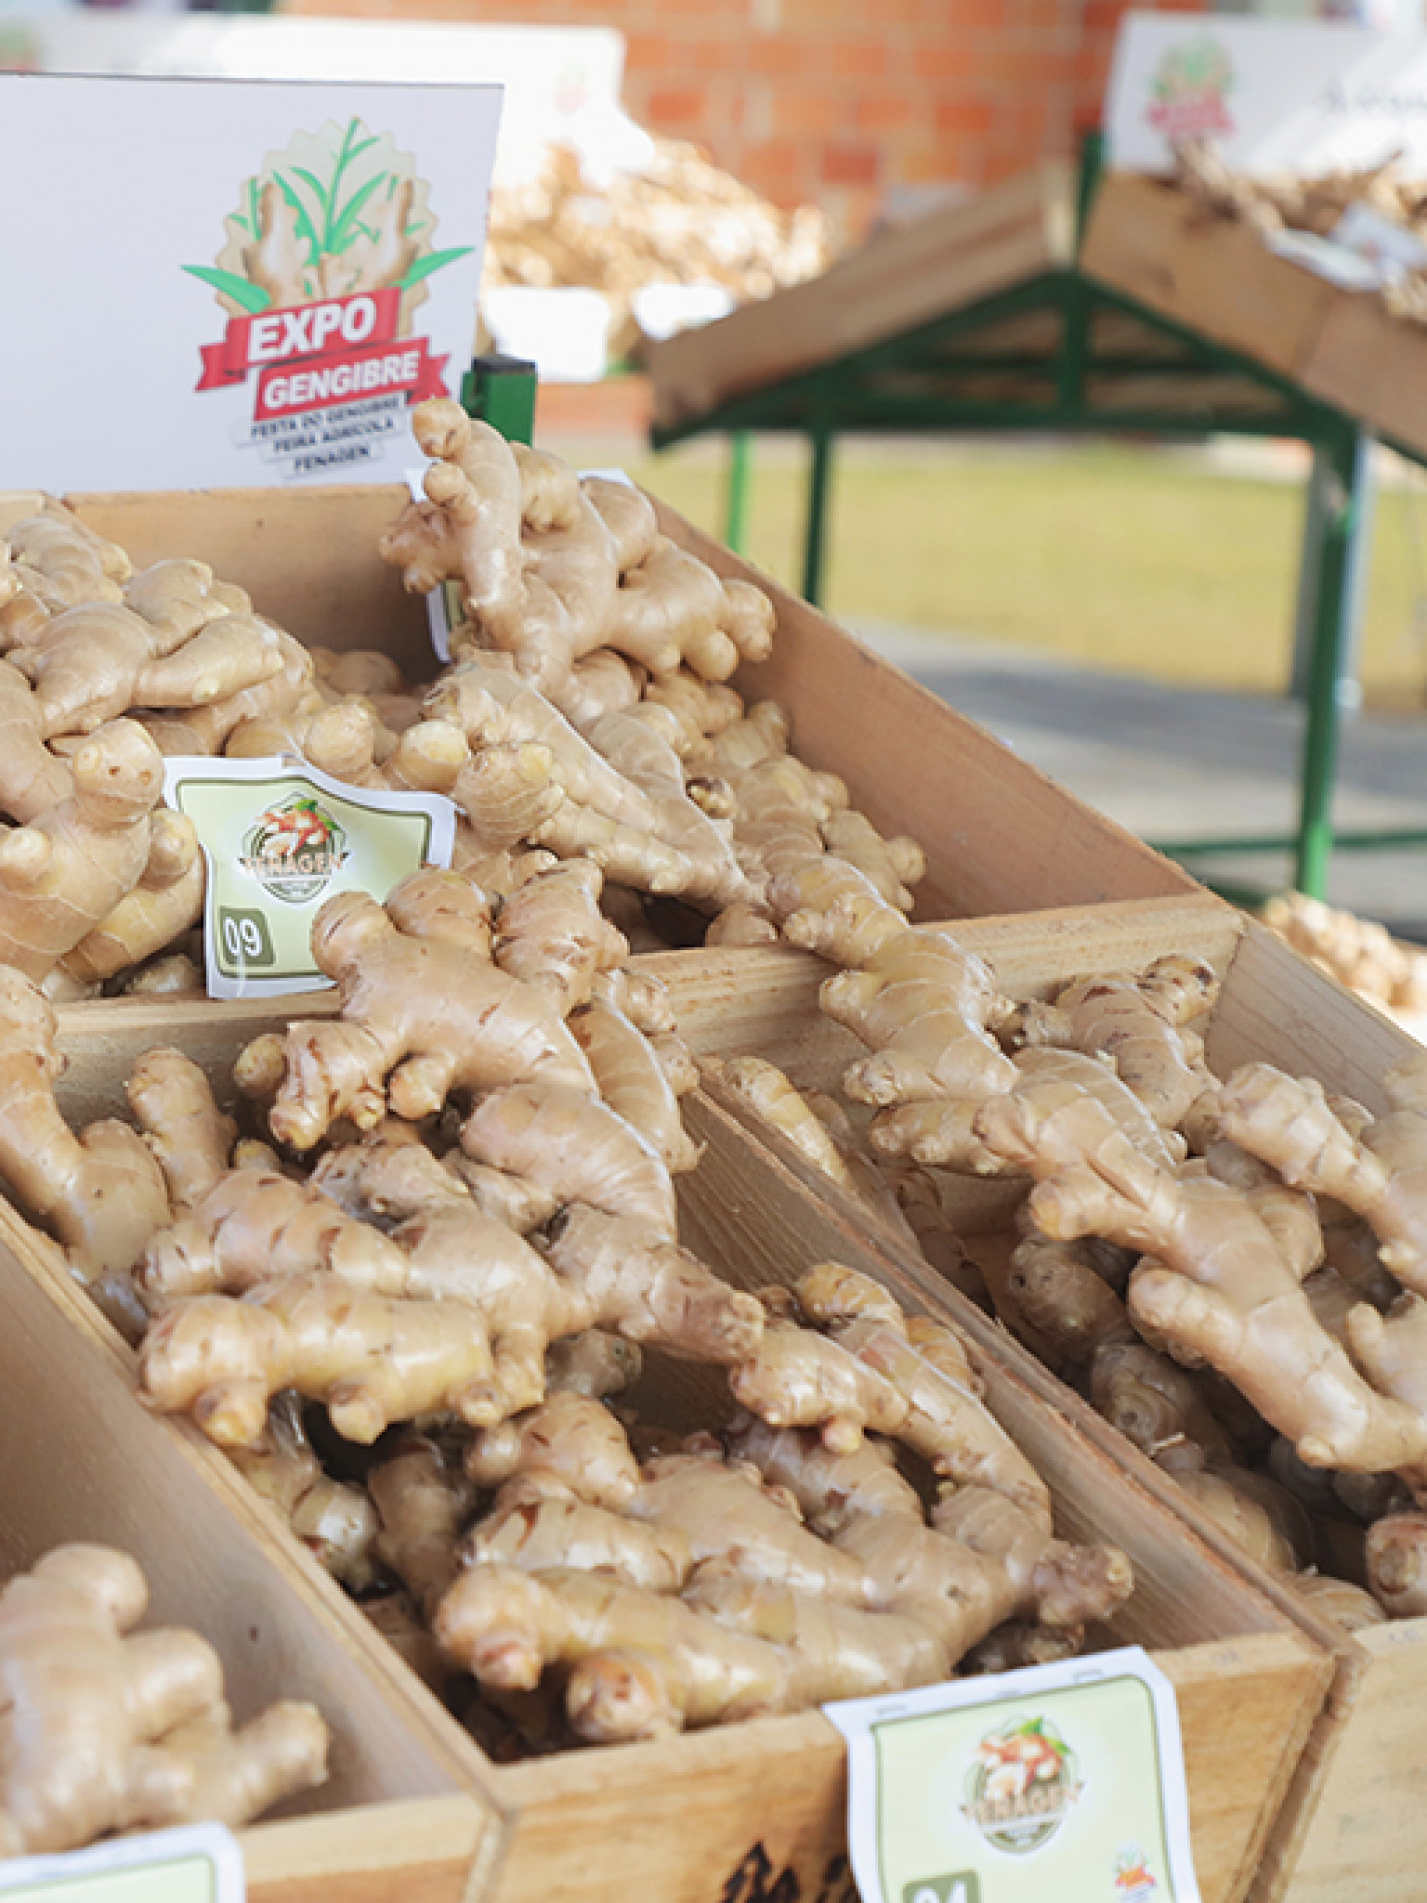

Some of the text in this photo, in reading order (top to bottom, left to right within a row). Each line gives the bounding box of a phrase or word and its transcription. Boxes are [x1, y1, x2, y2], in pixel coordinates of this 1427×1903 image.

[248, 297, 376, 361] EXPO
[264, 351, 419, 408] GENGIBRE
[223, 916, 263, 957] 09
